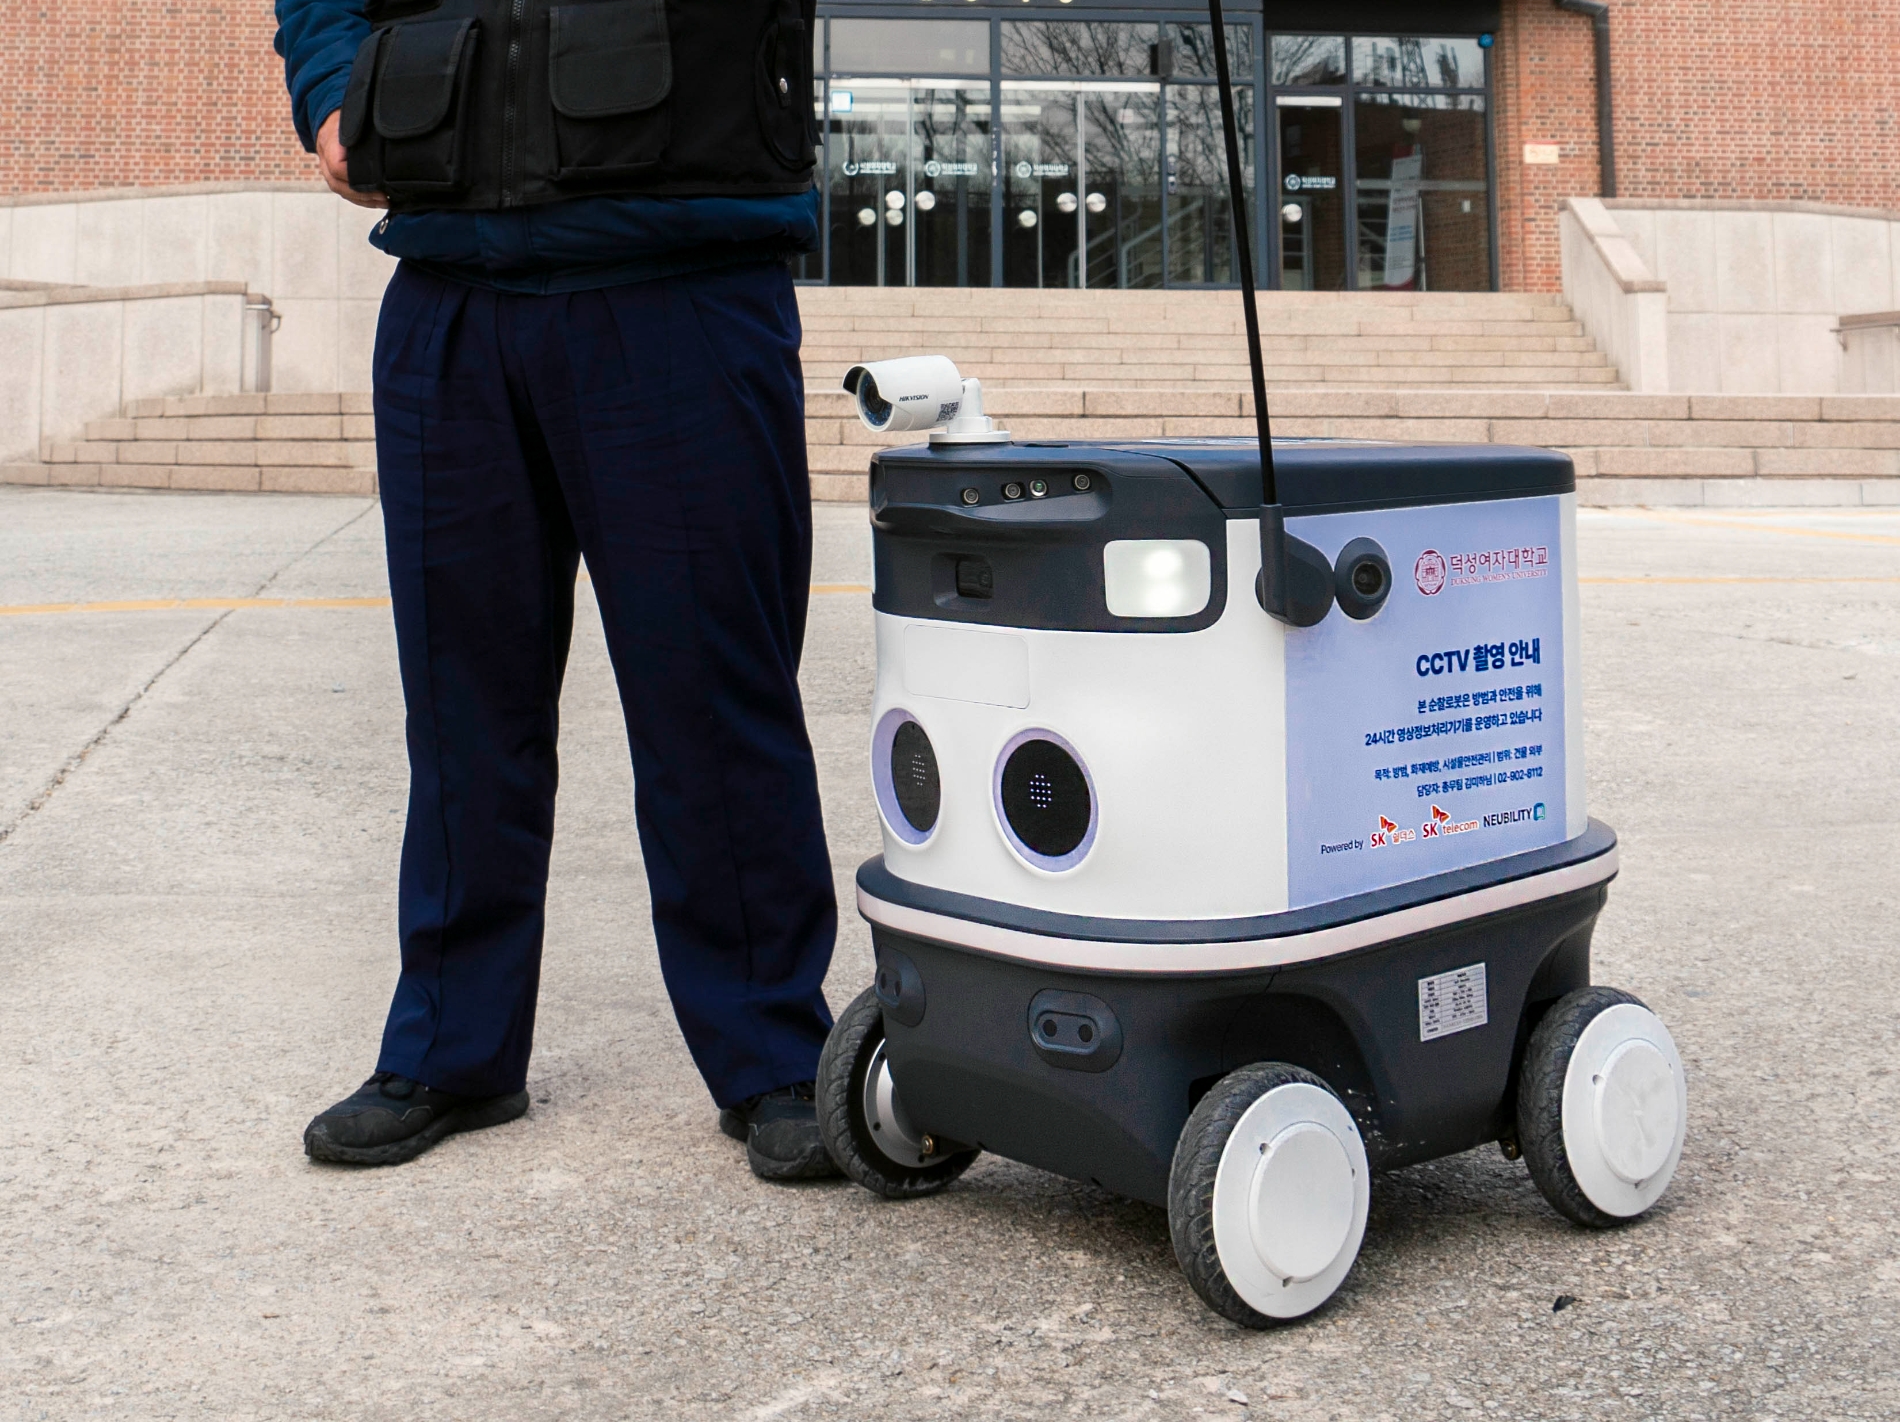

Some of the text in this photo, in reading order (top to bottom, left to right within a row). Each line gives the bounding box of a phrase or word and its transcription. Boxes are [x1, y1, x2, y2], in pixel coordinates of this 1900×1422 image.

[1450, 547, 1548, 575] 덕성여자대학교
[1450, 576, 1481, 586] DUKSUNG
[1512, 569, 1548, 579] UNIVERSITY
[1416, 638, 1541, 677] CCTV 촬영 안내
[1417, 683, 1542, 714] 본 순찰로봇은 방범과 안전을 위해
[1365, 707, 1543, 746] 24시간 영상정보처리기기를 운영하고 있습니다
[1529, 744, 1542, 756] 외부
[1321, 840, 1353, 854] Powered
[1354, 839, 1363, 850] by
[1371, 832, 1386, 847] SK
[1423, 822, 1438, 838] SK
[1442, 820, 1478, 834] telecom
[1483, 807, 1533, 827] NEUBILITY
